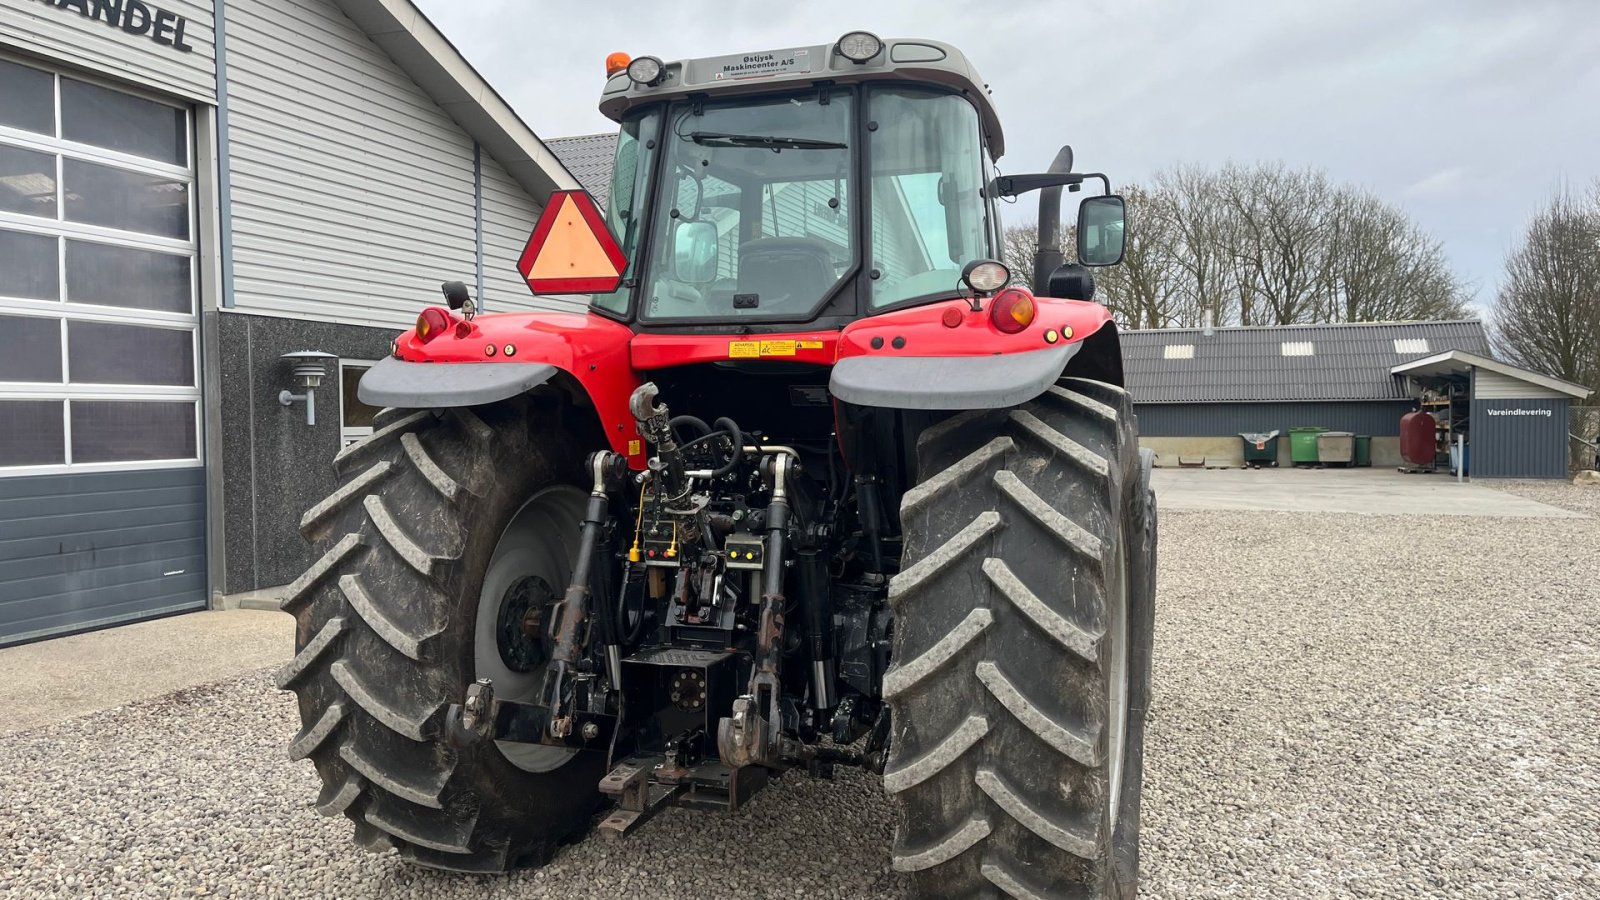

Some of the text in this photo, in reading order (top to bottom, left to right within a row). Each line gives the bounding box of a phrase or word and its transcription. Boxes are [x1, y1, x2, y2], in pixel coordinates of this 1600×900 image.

[45, 0, 192, 53] NDEL
[743, 54, 774, 63] Østjysk
[723, 61, 779, 72] Maskincenter
[781, 58, 795, 66] A/S
[1487, 408, 1552, 417] Vareindlevering
